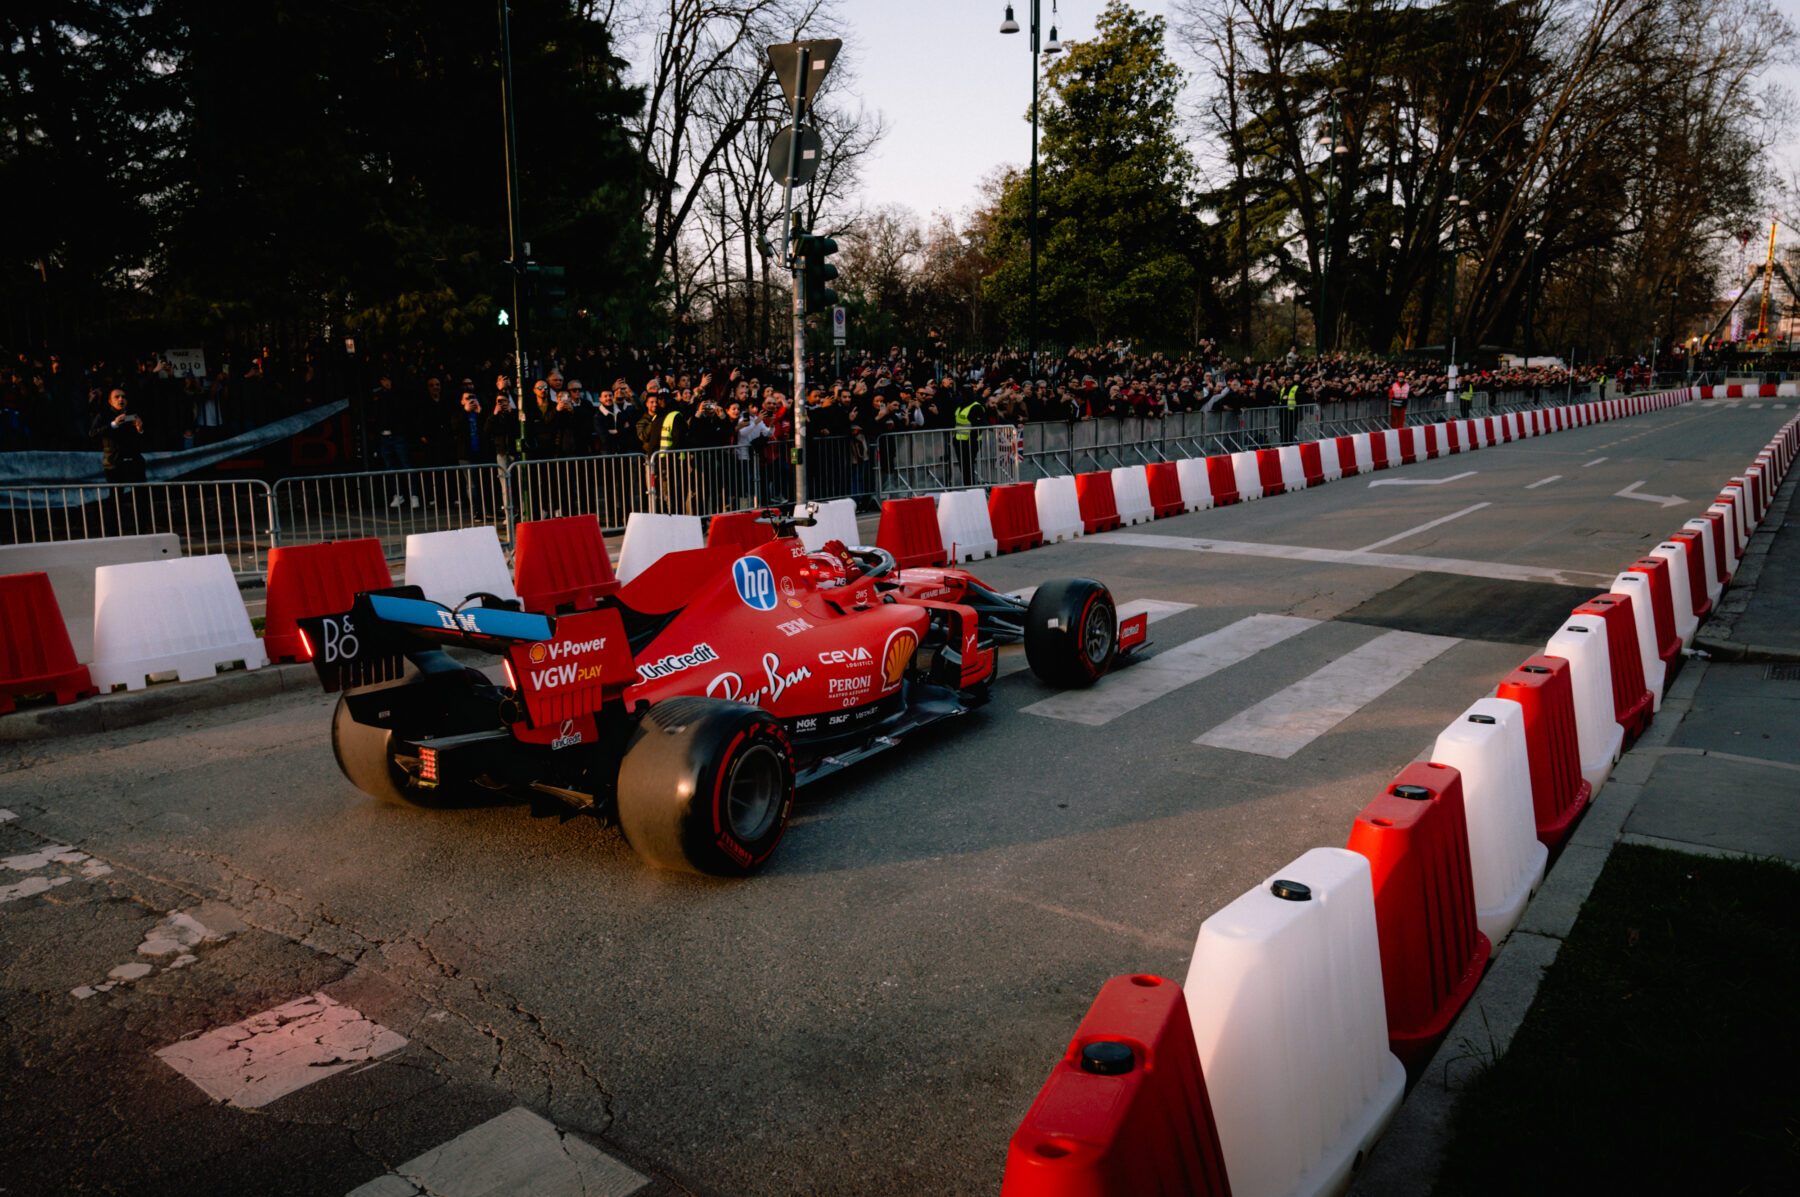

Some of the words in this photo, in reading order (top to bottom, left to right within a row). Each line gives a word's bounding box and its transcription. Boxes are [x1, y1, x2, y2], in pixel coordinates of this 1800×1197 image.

[740, 559, 769, 609] hp
[776, 617, 815, 637] IBM
[548, 637, 607, 660] V-Power
[640, 644, 717, 679] UniCredit
[846, 660, 874, 668] LOGISTICS
[531, 662, 578, 691] VGW
[577, 664, 603, 681] PLAY
[828, 674, 872, 693] PERONI
[749, 722, 760, 739] P
[796, 717, 817, 729] NGK
[829, 714, 850, 725] SKF
